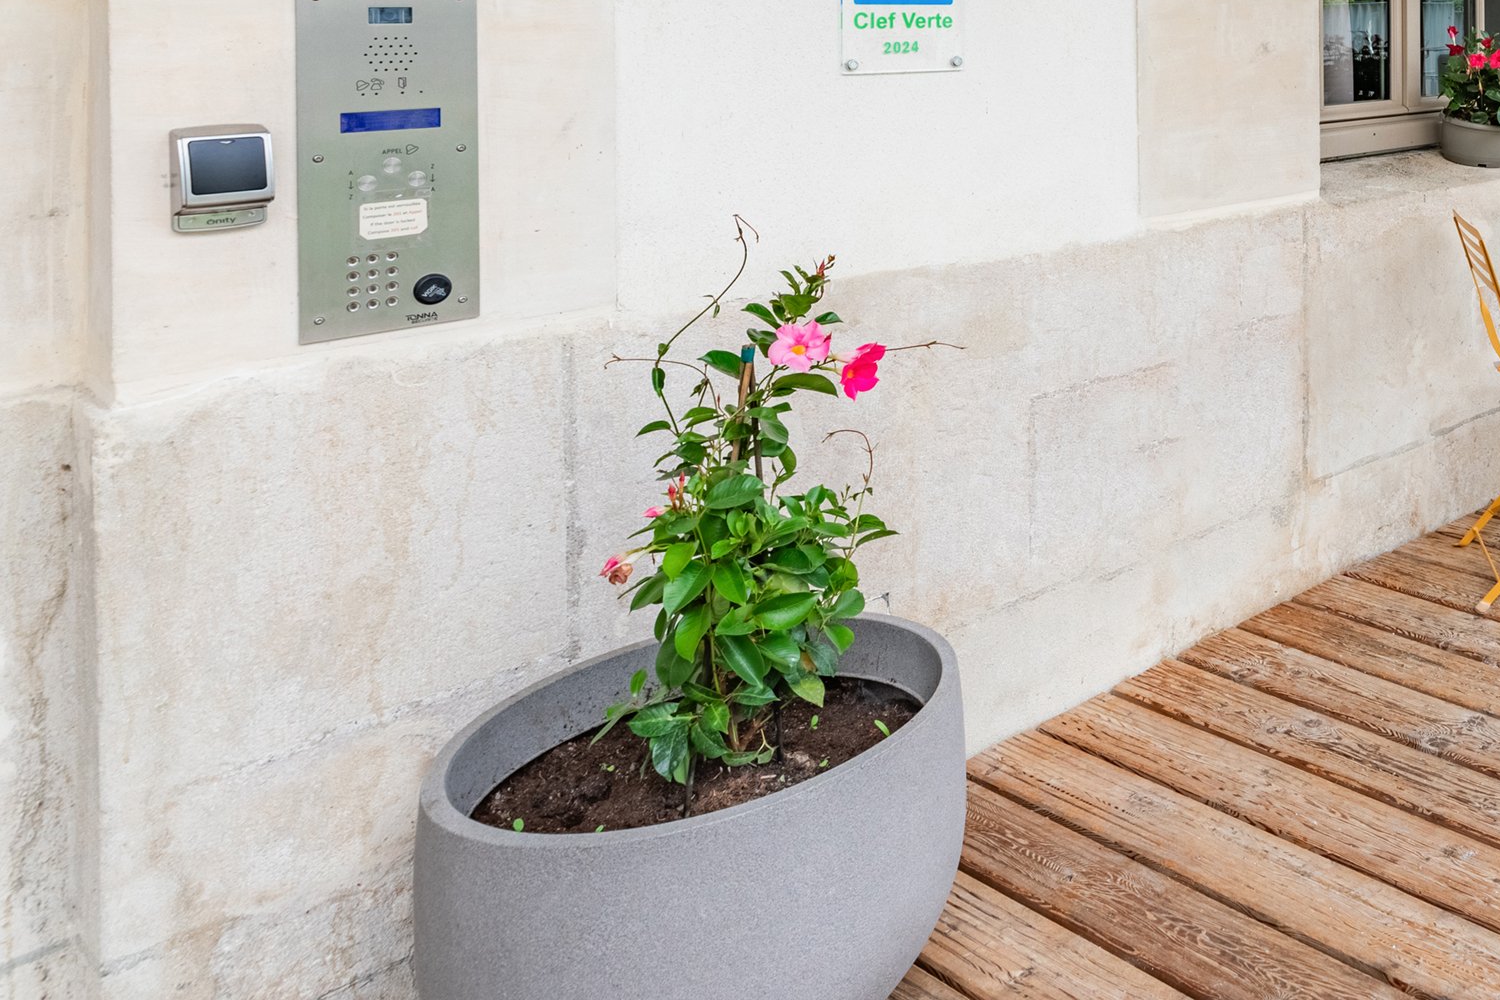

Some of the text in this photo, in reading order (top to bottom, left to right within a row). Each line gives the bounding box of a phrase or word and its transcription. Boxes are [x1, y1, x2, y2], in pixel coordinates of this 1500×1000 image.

[853, 12, 953, 30] Clef Verte
[883, 40, 919, 55] 2024
[405, 311, 438, 321] TONNA
